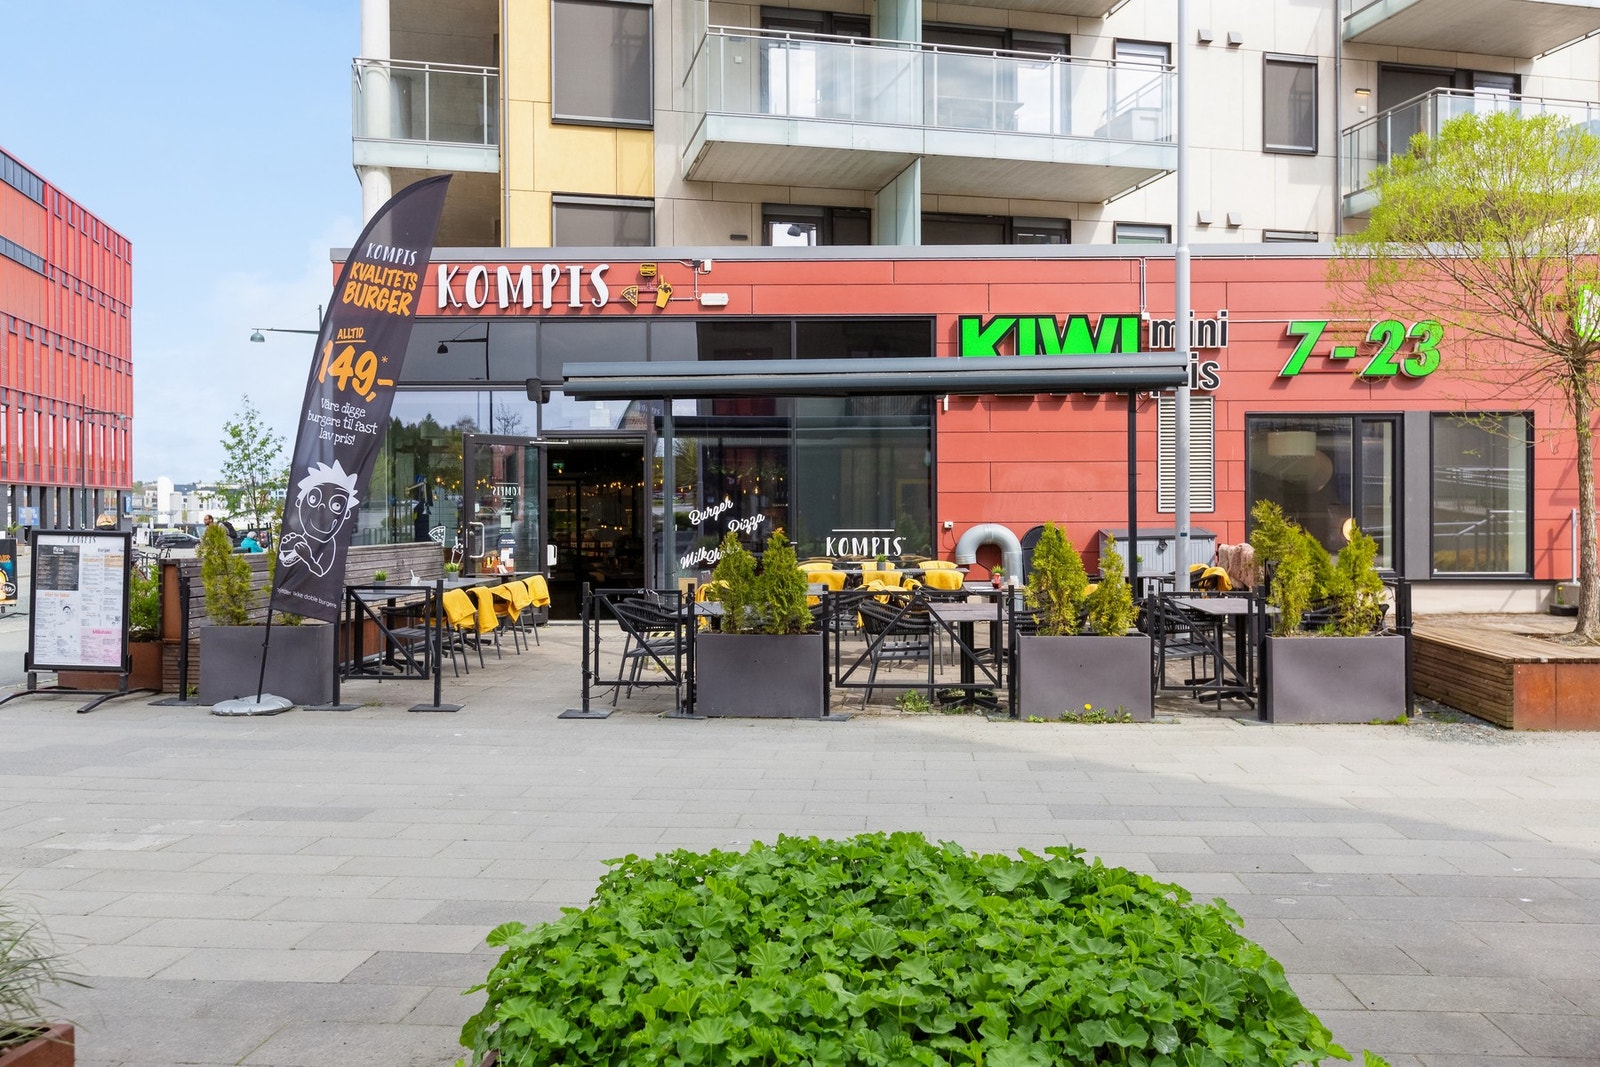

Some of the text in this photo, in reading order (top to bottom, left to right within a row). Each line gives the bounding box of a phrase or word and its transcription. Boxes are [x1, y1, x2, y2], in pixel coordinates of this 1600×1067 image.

[366, 243, 418, 266] KOMPIS
[349, 261, 418, 291] KVALITETS
[437, 263, 610, 310] KOMPIS
[342, 281, 413, 317] BURGER
[337, 326, 364, 340] ALLTID
[341, 402, 366, 419] digge
[307, 409, 378, 435] burgere til fast
[318, 427, 356, 446] lav pris!
[688, 500, 734, 525] Burger
[727, 513, 766, 535] Pizza
[826, 536, 903, 557] KOMPIS
[319, 598, 337, 608] burgere
